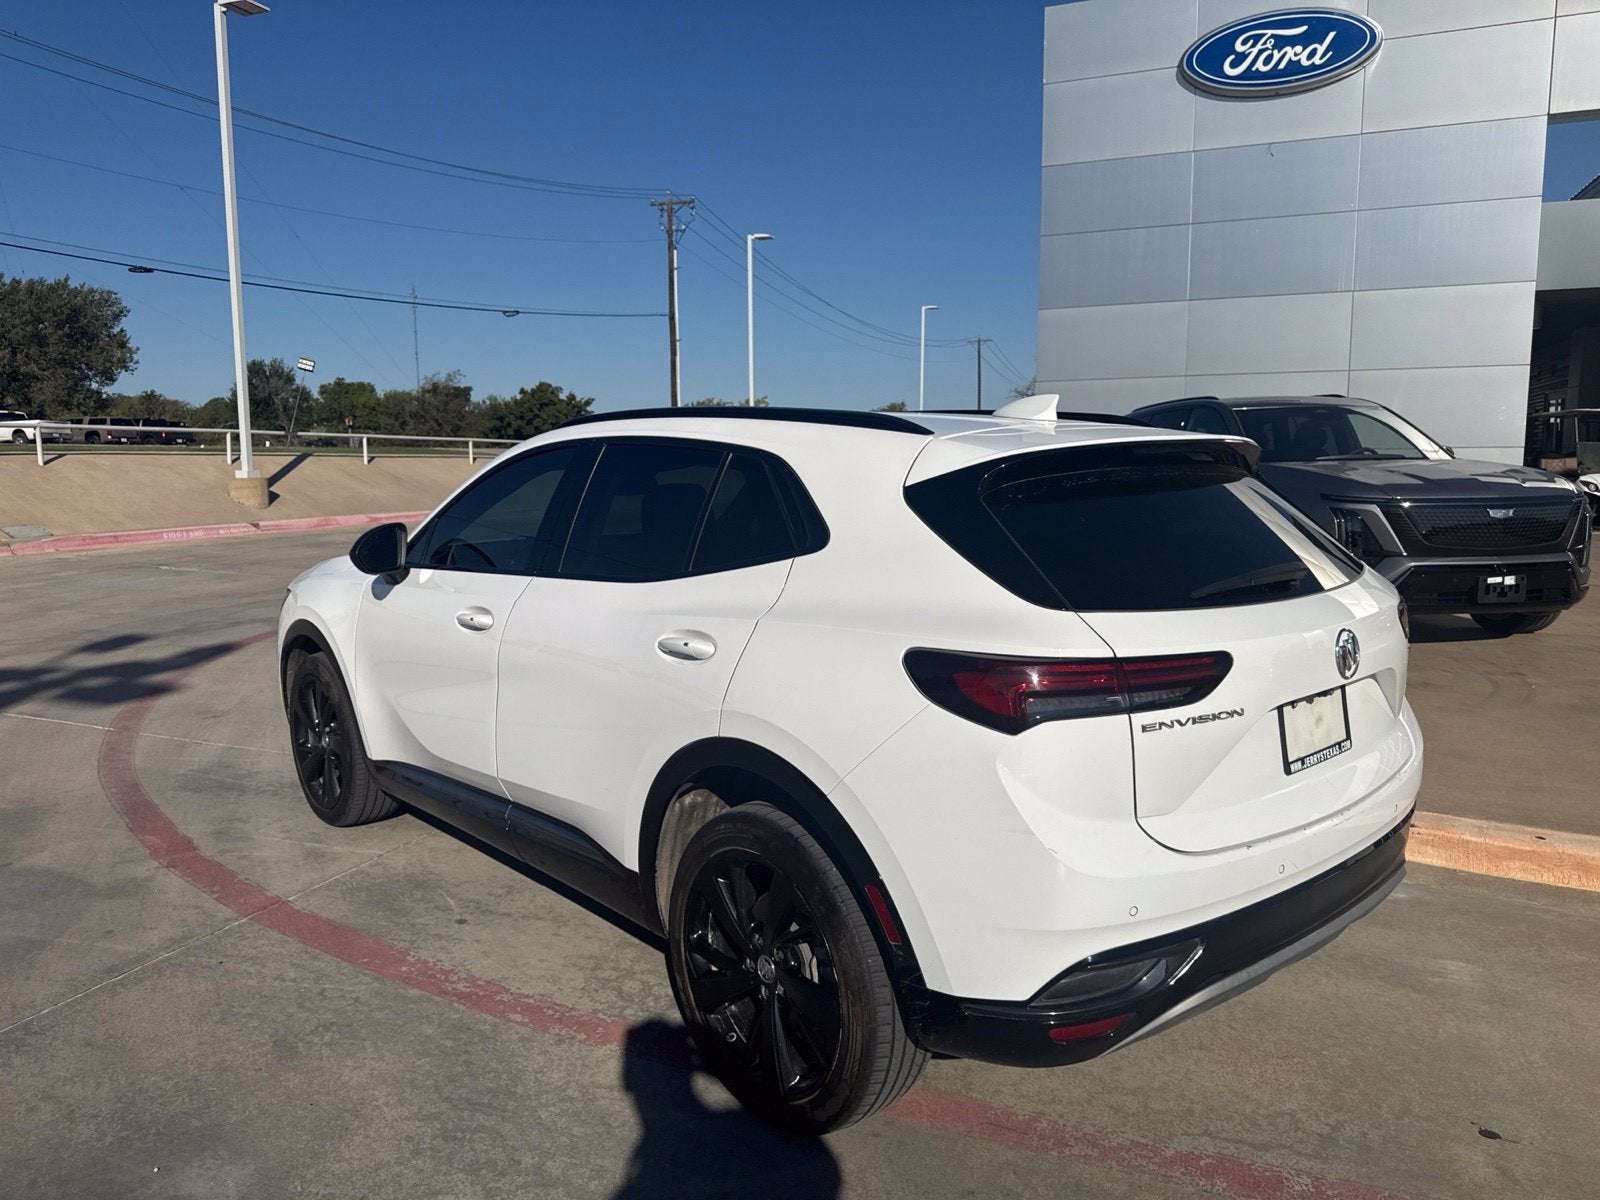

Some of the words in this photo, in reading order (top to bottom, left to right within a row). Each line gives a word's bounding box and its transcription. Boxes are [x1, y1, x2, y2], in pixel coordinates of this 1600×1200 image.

[1223, 25, 1337, 77] Ford
[1141, 707, 1244, 733] ENVISION
[1289, 740, 1351, 774] WWW.JERRYSTEXAS.COM
